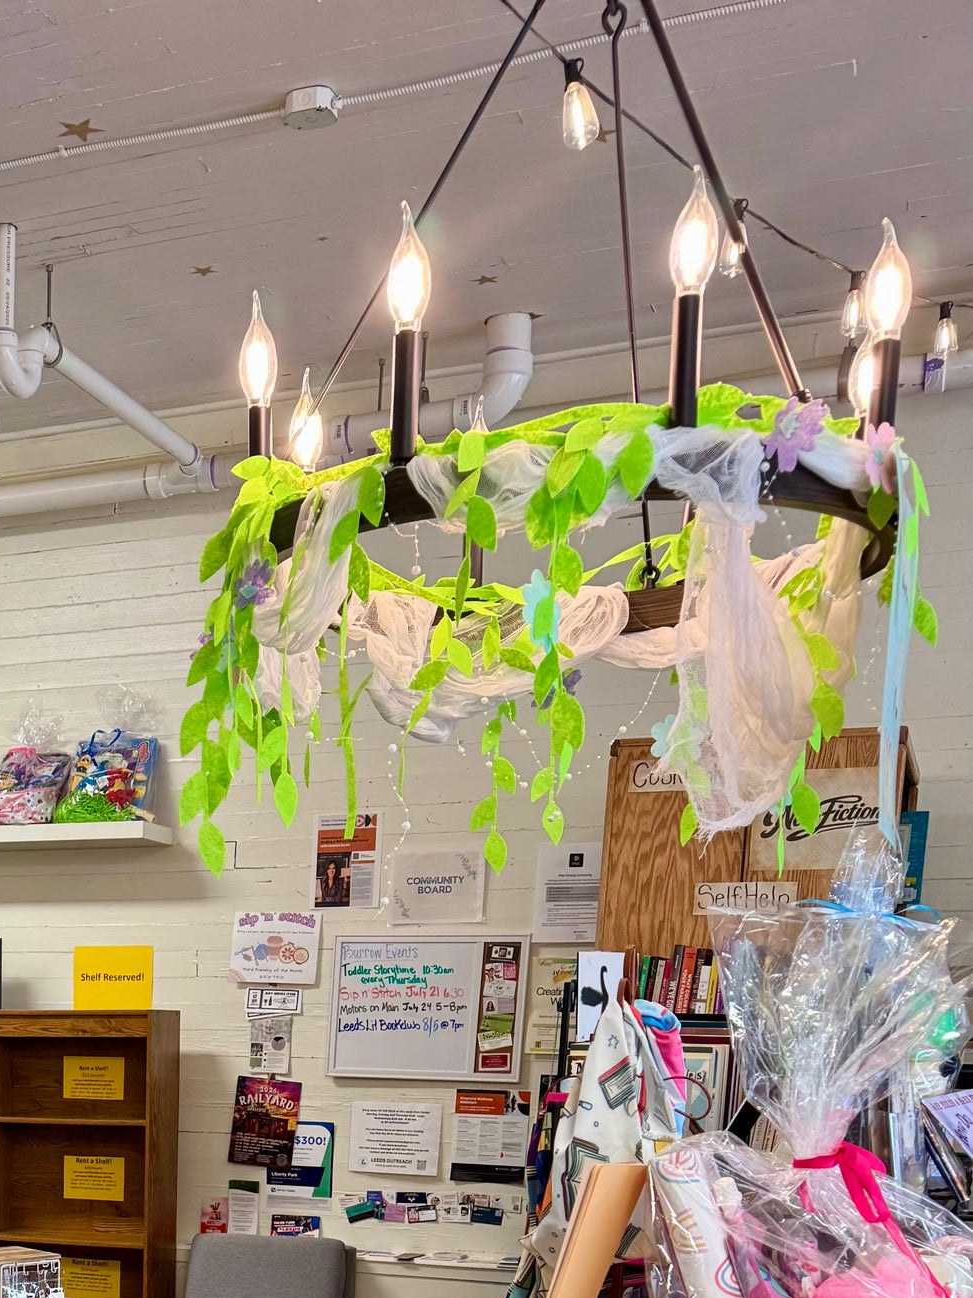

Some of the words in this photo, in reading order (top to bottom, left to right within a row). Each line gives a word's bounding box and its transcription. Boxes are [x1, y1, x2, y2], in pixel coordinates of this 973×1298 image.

[406, 875, 465, 886] COMMUNITY
[417, 885, 453, 894] BOARD
[238, 913, 259, 927] sip
[278, 912, 316, 929] stitch
[342, 944, 382, 961] Burrow
[385, 944, 419, 960] Events
[80, 972, 101, 982] Shelf
[103, 972, 145, 982] Reserved!
[341, 963, 372, 977] Toddler
[373, 964, 417, 978] Storytime
[360, 976, 386, 988] every
[386, 974, 428, 989] Thursday
[339, 987, 360, 1001] Sip
[371, 986, 401, 999] Stitch
[405, 985, 427, 999] July
[340, 1004, 368, 1016] Motors
[369, 1004, 380, 1013] on
[381, 1003, 399, 1013] Main
[402, 1003, 419, 1013] July
[421, 1003, 432, 1013] 24
[338, 1018, 366, 1033] Leeds
[365, 1018, 378, 1031] Lit
[422, 1017, 439, 1038] 8/5
[440, 1020, 449, 1029] @
[450, 1019, 465, 1033] 7pm
[259, 1086, 277, 1094] 2026
[238, 1093, 295, 1111] RAILYARD
[294, 1136, 327, 1146] $300!
[75, 1156, 89, 1165] Rent
[94, 1157, 113, 1165] Shelf!
[71, 1258, 85, 1266] Rent
[91, 1259, 108, 1268] Shelf!
